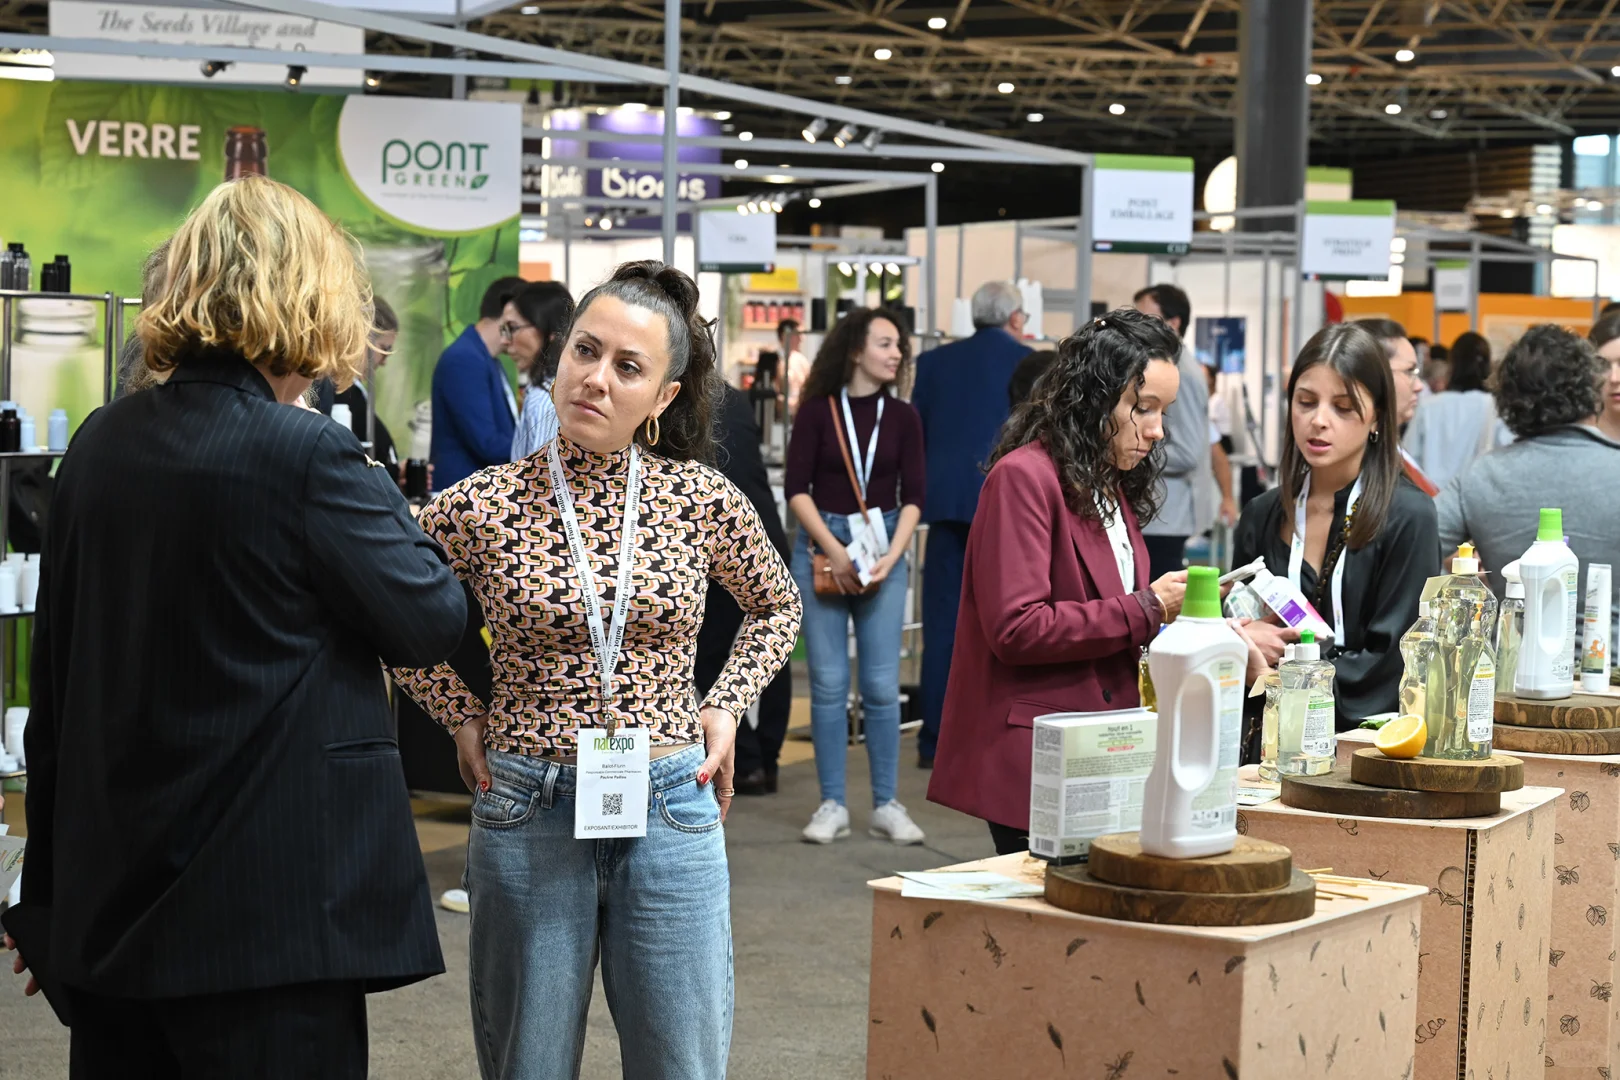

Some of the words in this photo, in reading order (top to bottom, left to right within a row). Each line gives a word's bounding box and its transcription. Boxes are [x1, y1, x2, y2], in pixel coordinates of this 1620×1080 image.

[98, 9, 133, 31] The
[139, 12, 195, 32] Seeds
[201, 14, 270, 43] Village
[276, 18, 318, 38] and
[66, 119, 201, 161] VERRE
[394, 173, 466, 188] GREEN
[601, 157, 706, 200] Biois
[1110, 209, 1174, 220] EMBALLAGE
[594, 737, 634, 754] natexpo
